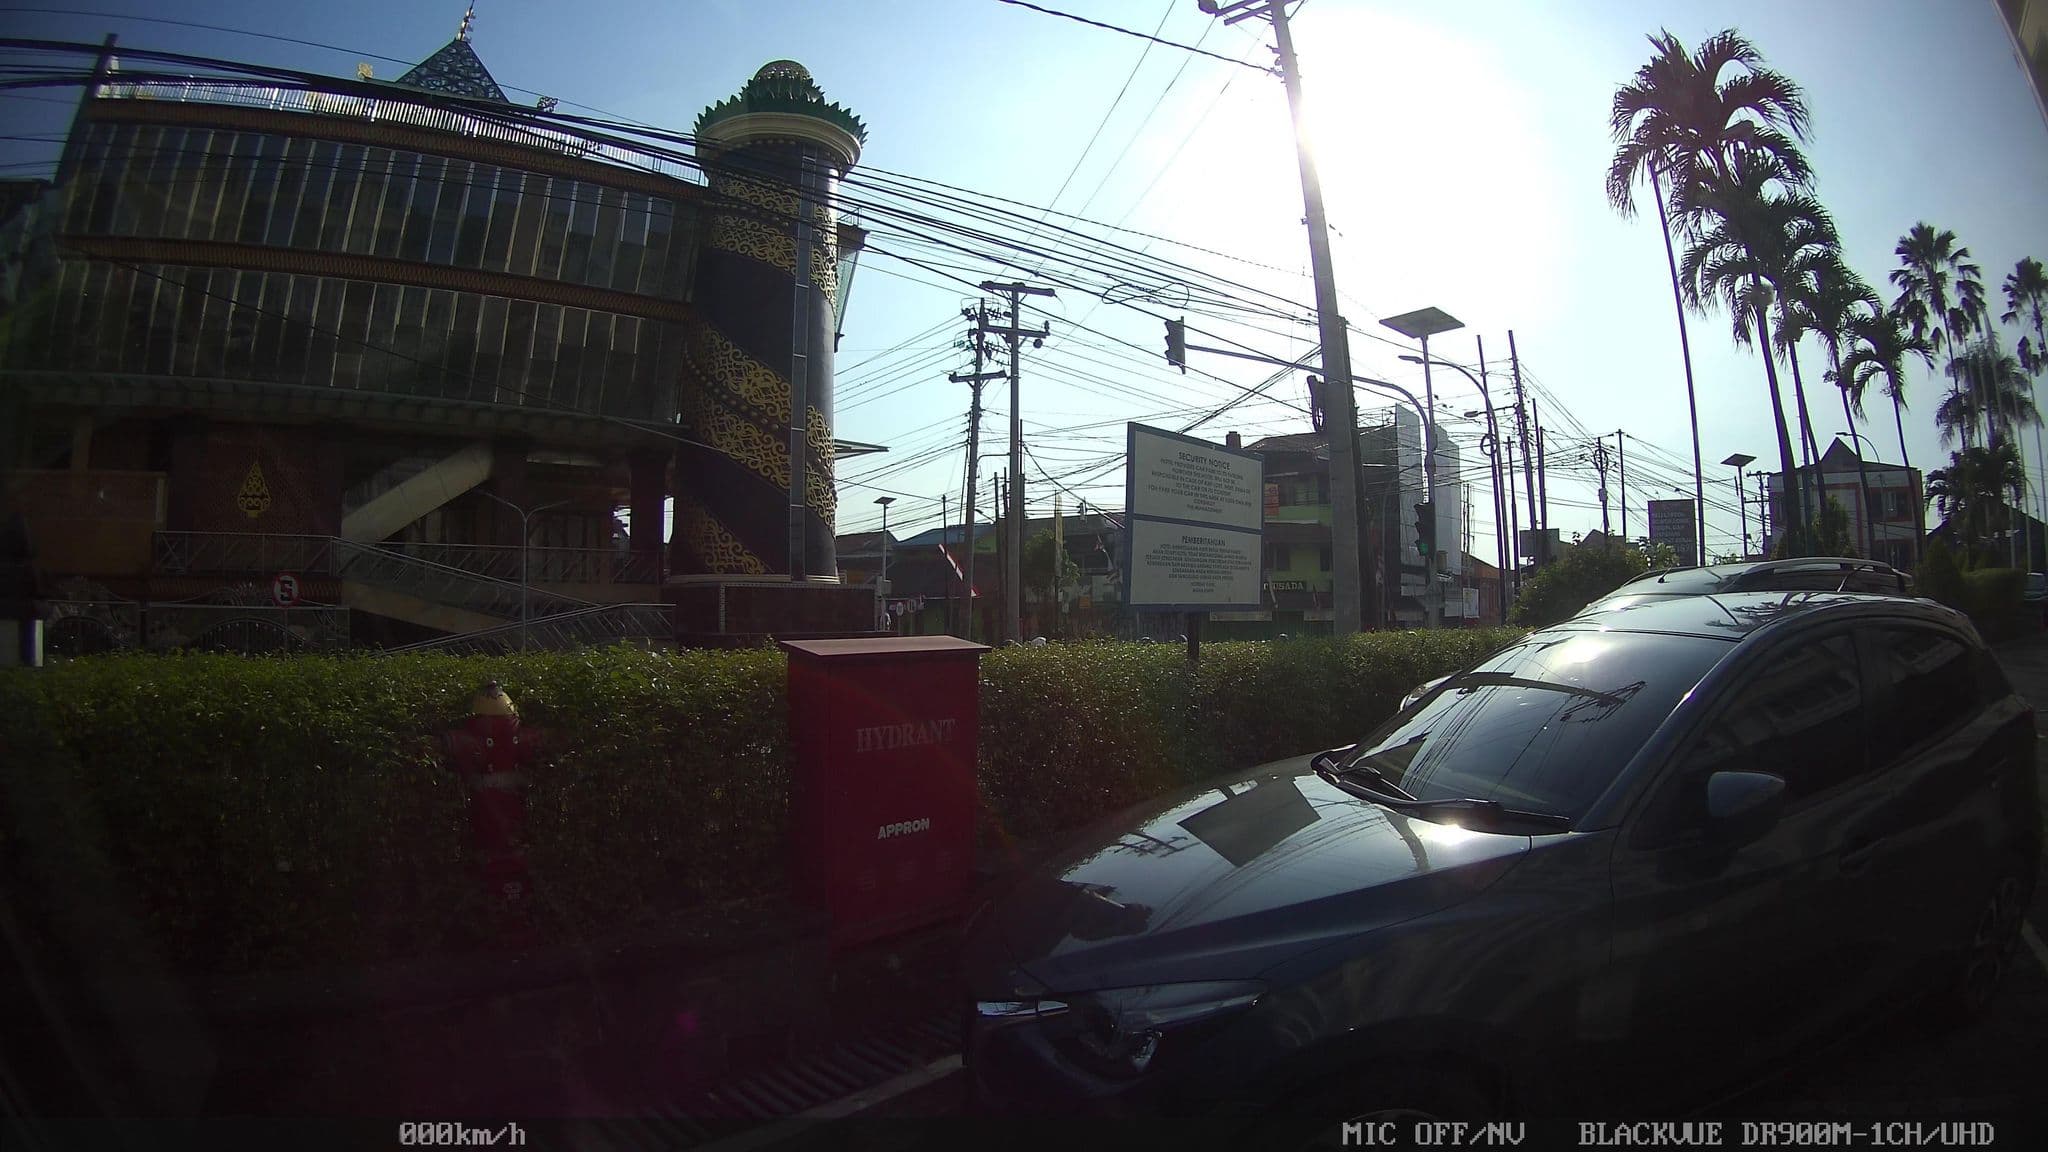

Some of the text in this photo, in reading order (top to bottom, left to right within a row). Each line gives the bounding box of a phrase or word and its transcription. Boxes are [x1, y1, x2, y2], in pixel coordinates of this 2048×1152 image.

[1179, 451, 1231, 470] SECURITY NOTICE
[856, 718, 956, 753] HYDRANT
[878, 818, 930, 840] APPRON
